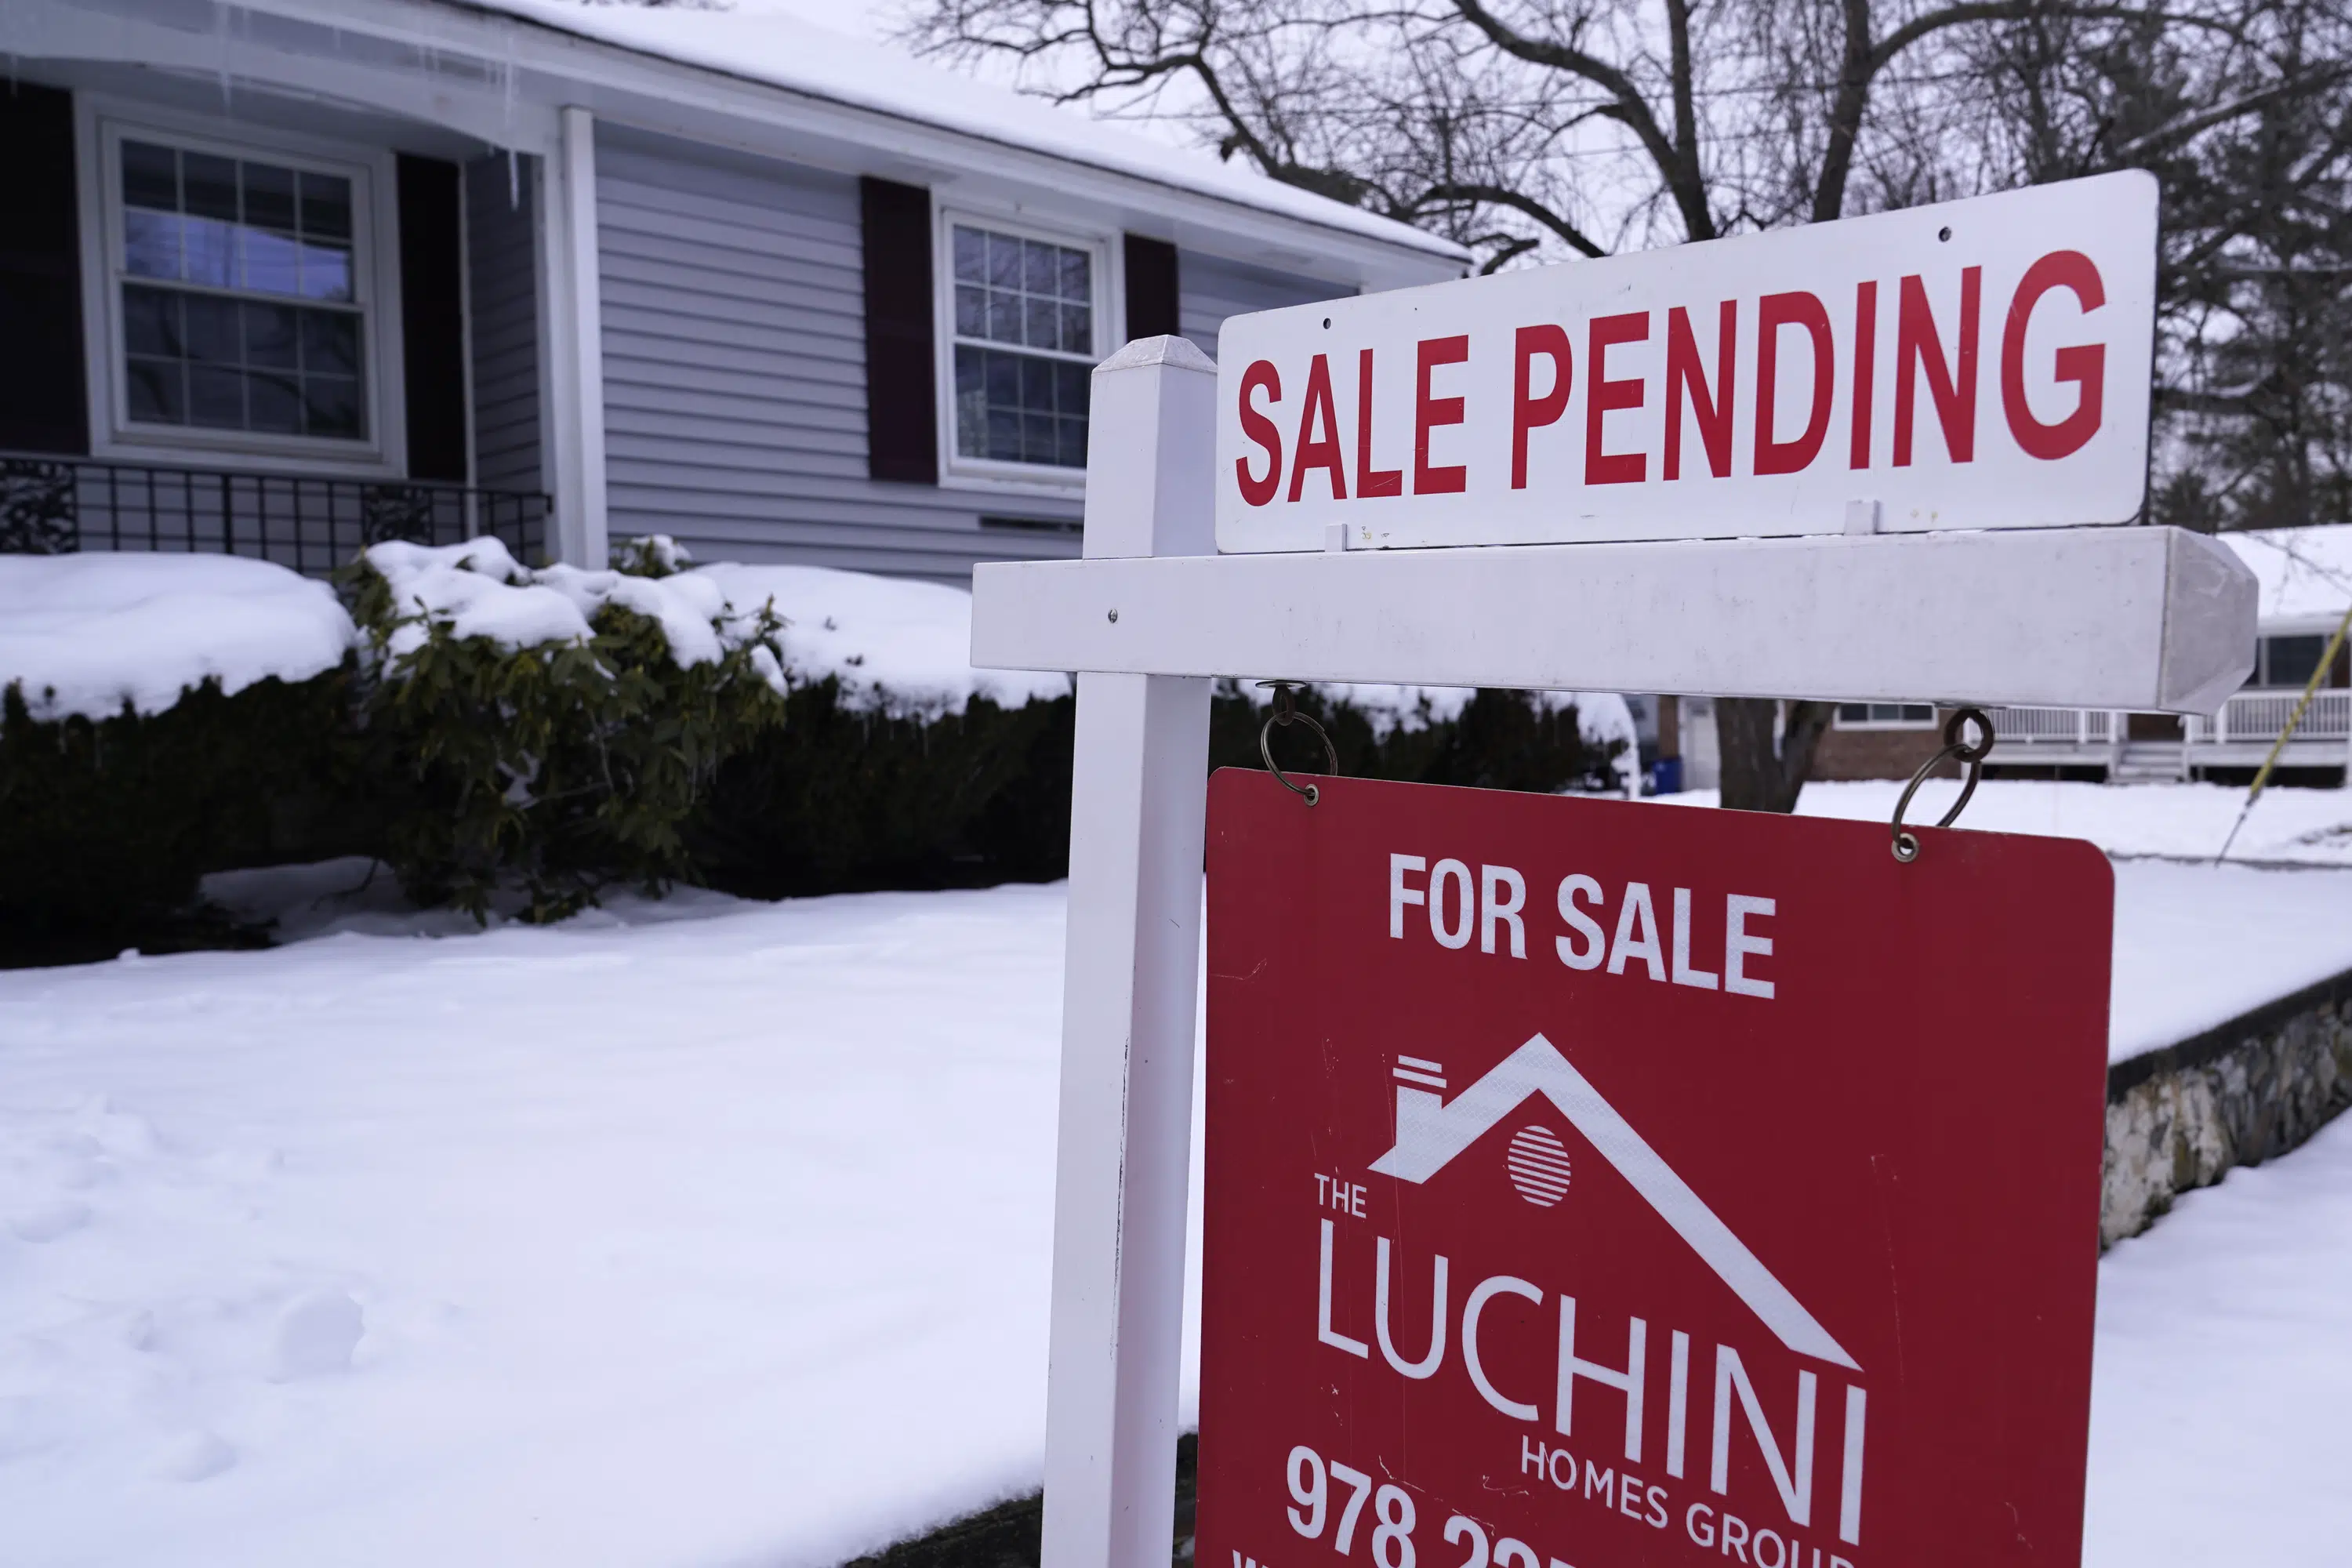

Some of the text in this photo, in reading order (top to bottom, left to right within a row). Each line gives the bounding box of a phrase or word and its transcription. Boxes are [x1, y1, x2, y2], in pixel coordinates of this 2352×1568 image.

[1236, 249, 2106, 506] SALE PENDING
[1389, 852, 1777, 1000] FOR SALE
[1314, 1172, 1367, 1219] THE
[1317, 1217, 1867, 1547] LUCHINI
[1287, 1445, 1417, 1568] 978
[1521, 1435, 1669, 1529] HOMES
